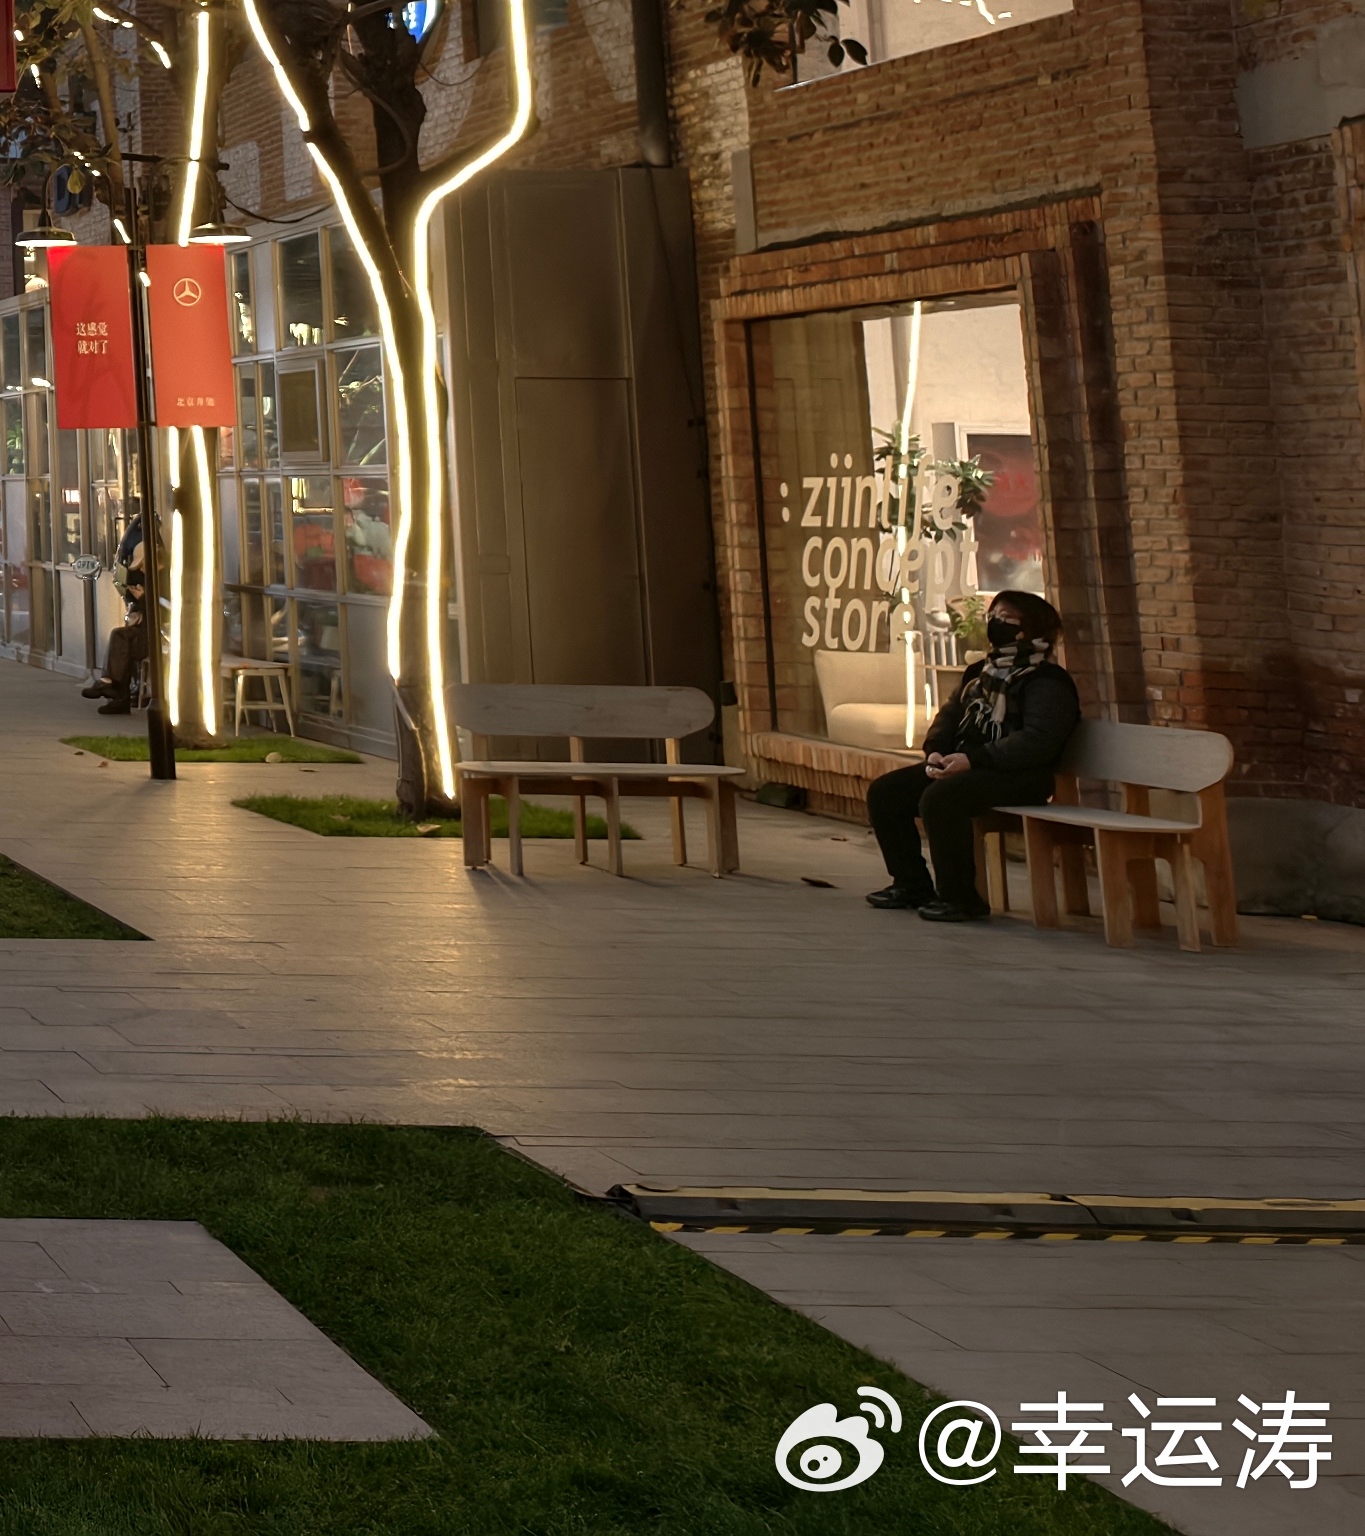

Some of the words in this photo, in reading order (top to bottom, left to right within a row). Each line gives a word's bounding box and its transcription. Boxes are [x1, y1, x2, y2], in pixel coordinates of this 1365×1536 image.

[76, 321, 109, 338] 这感觉
[77, 339, 109, 355] 就对了
[801, 534, 979, 613] concept
[801, 595, 916, 654] store
